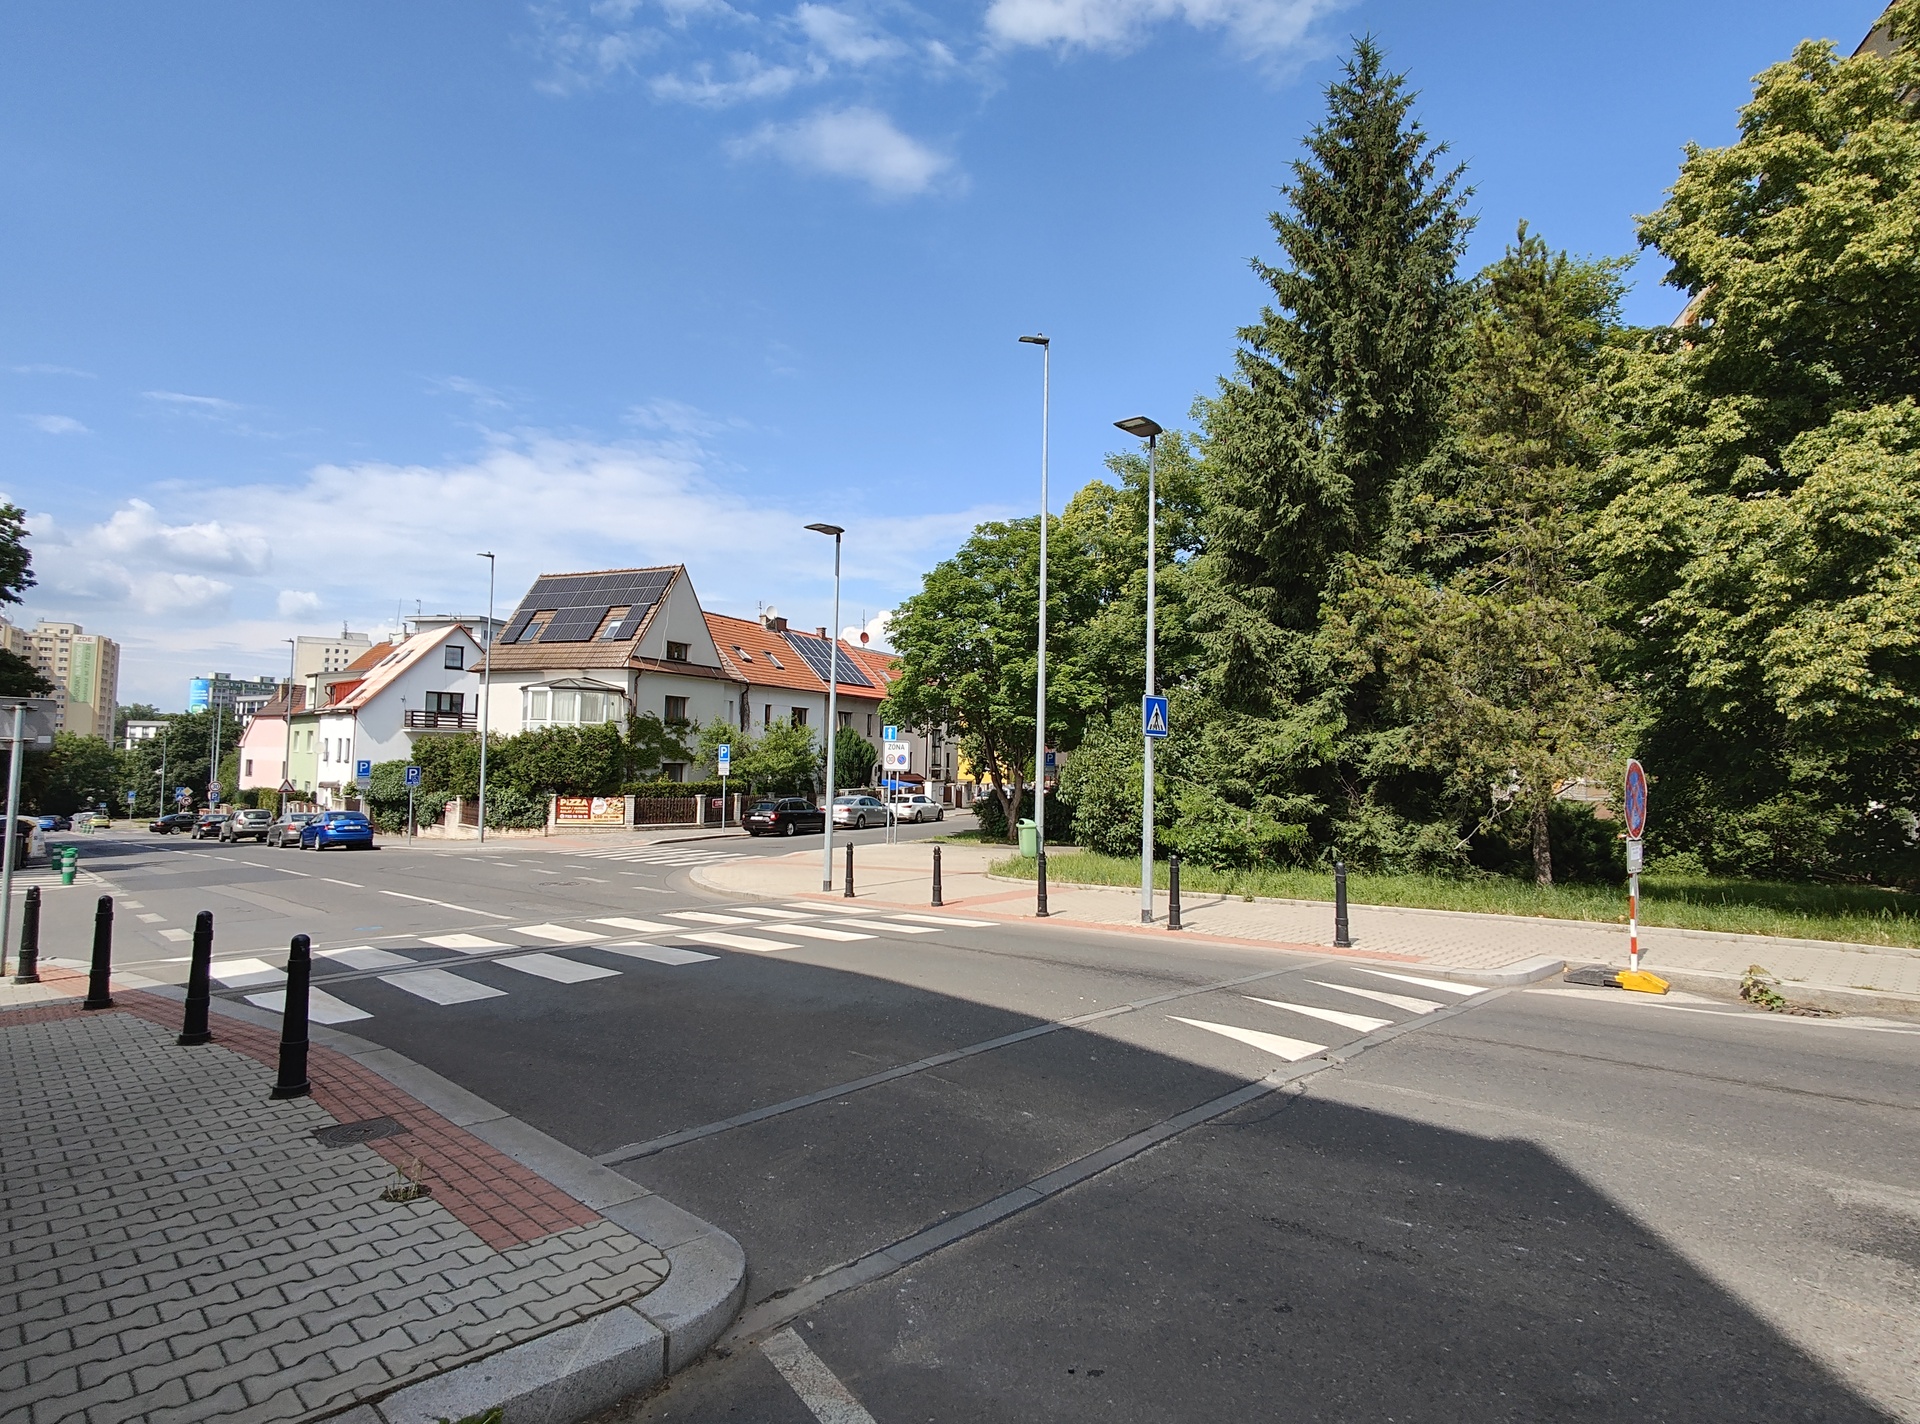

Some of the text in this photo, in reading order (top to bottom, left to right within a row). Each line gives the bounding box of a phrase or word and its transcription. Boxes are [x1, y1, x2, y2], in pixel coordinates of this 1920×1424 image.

[721, 747, 728, 757] P
[1047, 754, 1053, 762] P
[360, 762, 368, 772] P
[409, 769, 417, 780] P
